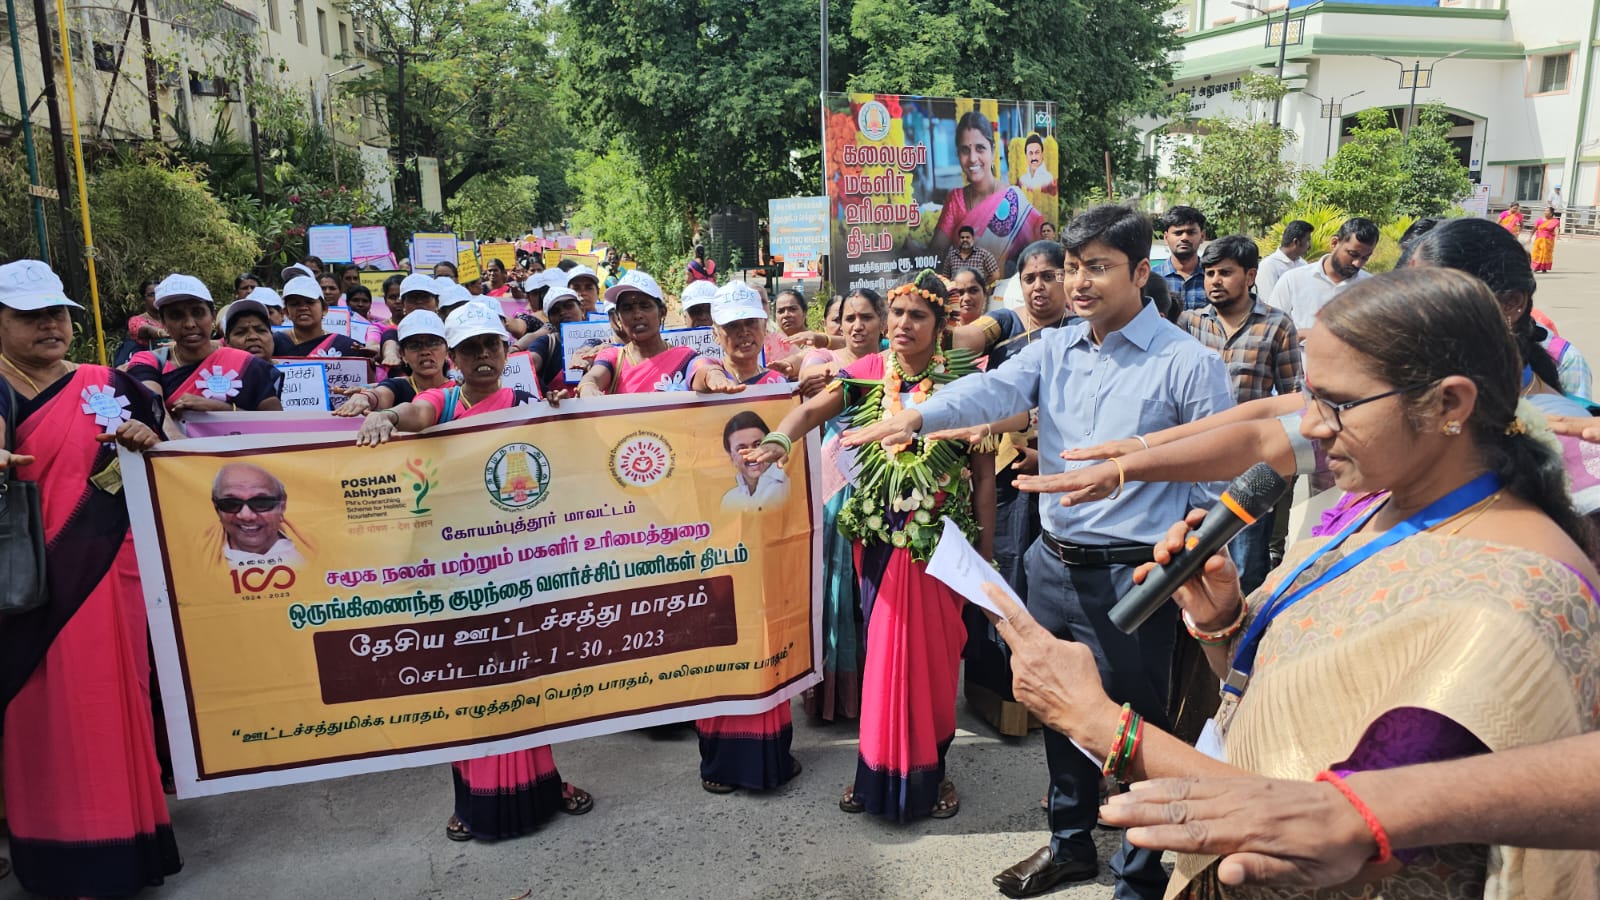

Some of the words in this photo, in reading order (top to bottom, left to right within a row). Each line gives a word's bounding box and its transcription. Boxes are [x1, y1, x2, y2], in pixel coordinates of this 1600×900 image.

[843, 142, 926, 170] கலைஞர்
[844, 167, 905, 195] மகளிர்
[846, 199, 921, 226] உரிமைத்
[847, 227, 893, 258] திட்டம்
[915, 255, 941, 269] 1000/-
[341, 474, 397, 489] POSHAN
[343, 486, 402, 500] Abhiyaan
[361, 497, 401, 506] Overarching
[347, 512, 388, 520] Nourishment
[441, 512, 557, 542] கோயம்புத்தூர்
[564, 500, 637, 523] மாவட்டம்
[326, 567, 378, 588] சமூக
[382, 558, 437, 585] நலன்
[442, 546, 514, 576] மற்றும்
[518, 533, 579, 562] மகளிர்
[584, 522, 711, 550] உரிமைத்துறை
[230, 565, 296, 594] 100
[289, 590, 445, 629] ஒருங்கிணைந்த
[449, 578, 534, 613] குழந்தை
[537, 559, 621, 592] வளர்ச்சிப்
[624, 549, 697, 579] பணிகள்
[700, 542, 749, 572] திட்டம்
[350, 628, 445, 662] தேசிய
[453, 601, 622, 645] ஊட்டச்சத்து
[630, 585, 709, 617] மாதம்
[549, 646, 559, 665] 1
[621, 629, 665, 653] 2023
[389, 705, 449, 725] பாரதம்,
[455, 693, 541, 718] எழுத்தறிவு
[544, 682, 594, 702] பெற்ற
[598, 671, 653, 692] பாரதம்,
[658, 660, 750, 682] வலிமையான
